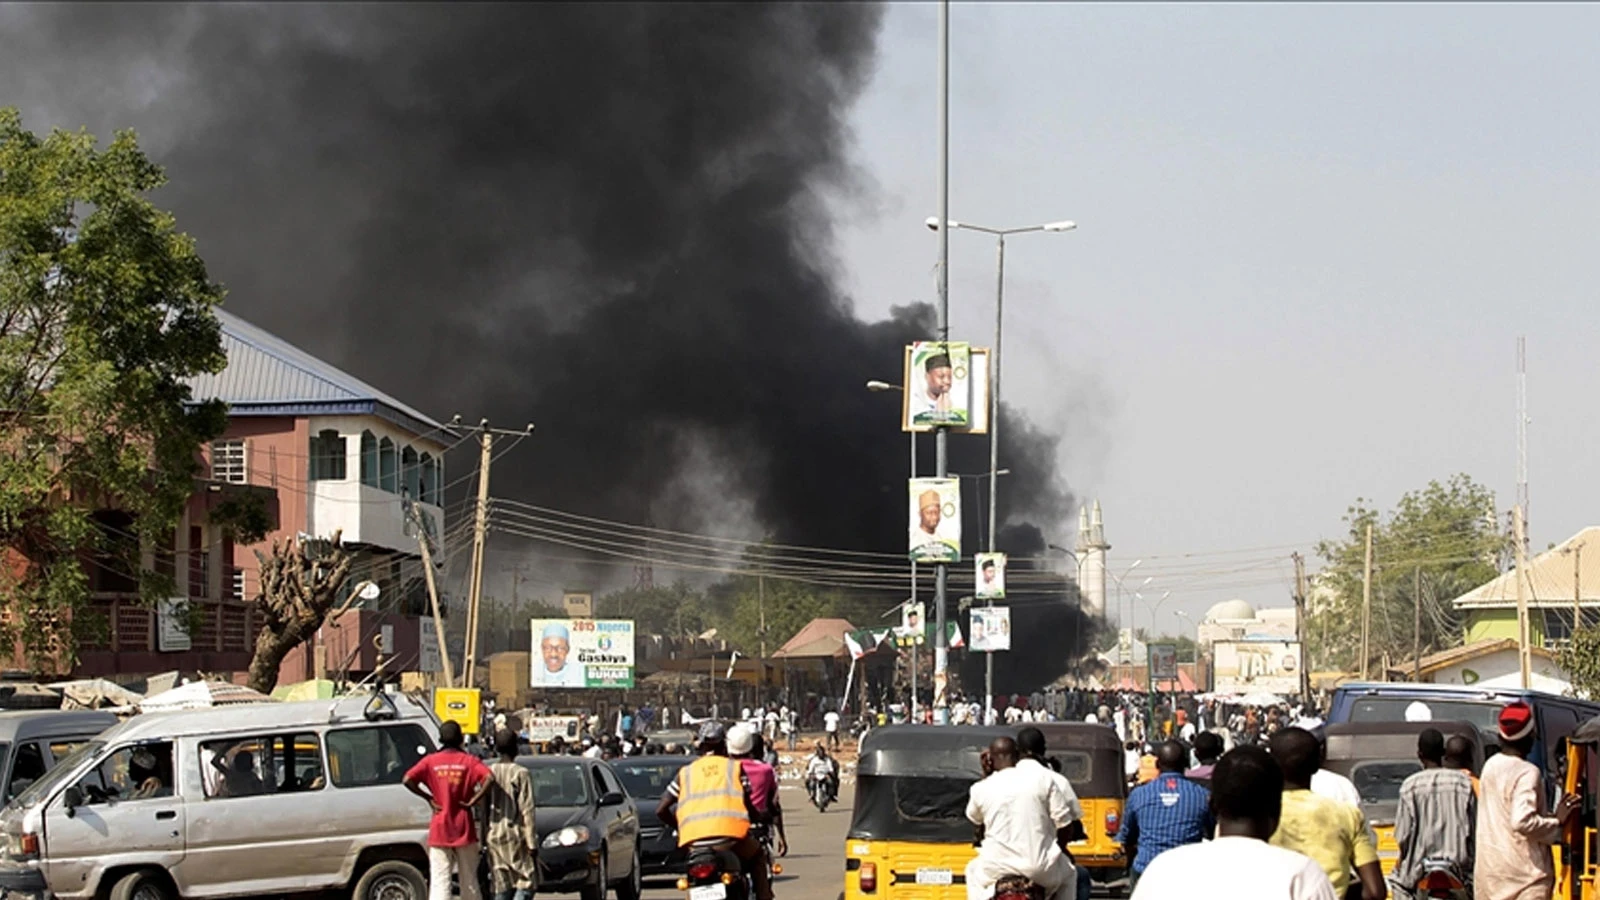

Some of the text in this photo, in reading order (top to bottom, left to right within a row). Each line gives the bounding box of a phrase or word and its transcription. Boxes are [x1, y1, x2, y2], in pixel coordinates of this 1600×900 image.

[573, 621, 631, 633] 2015 Nigeria
[578, 653, 627, 664] Gaskiya
